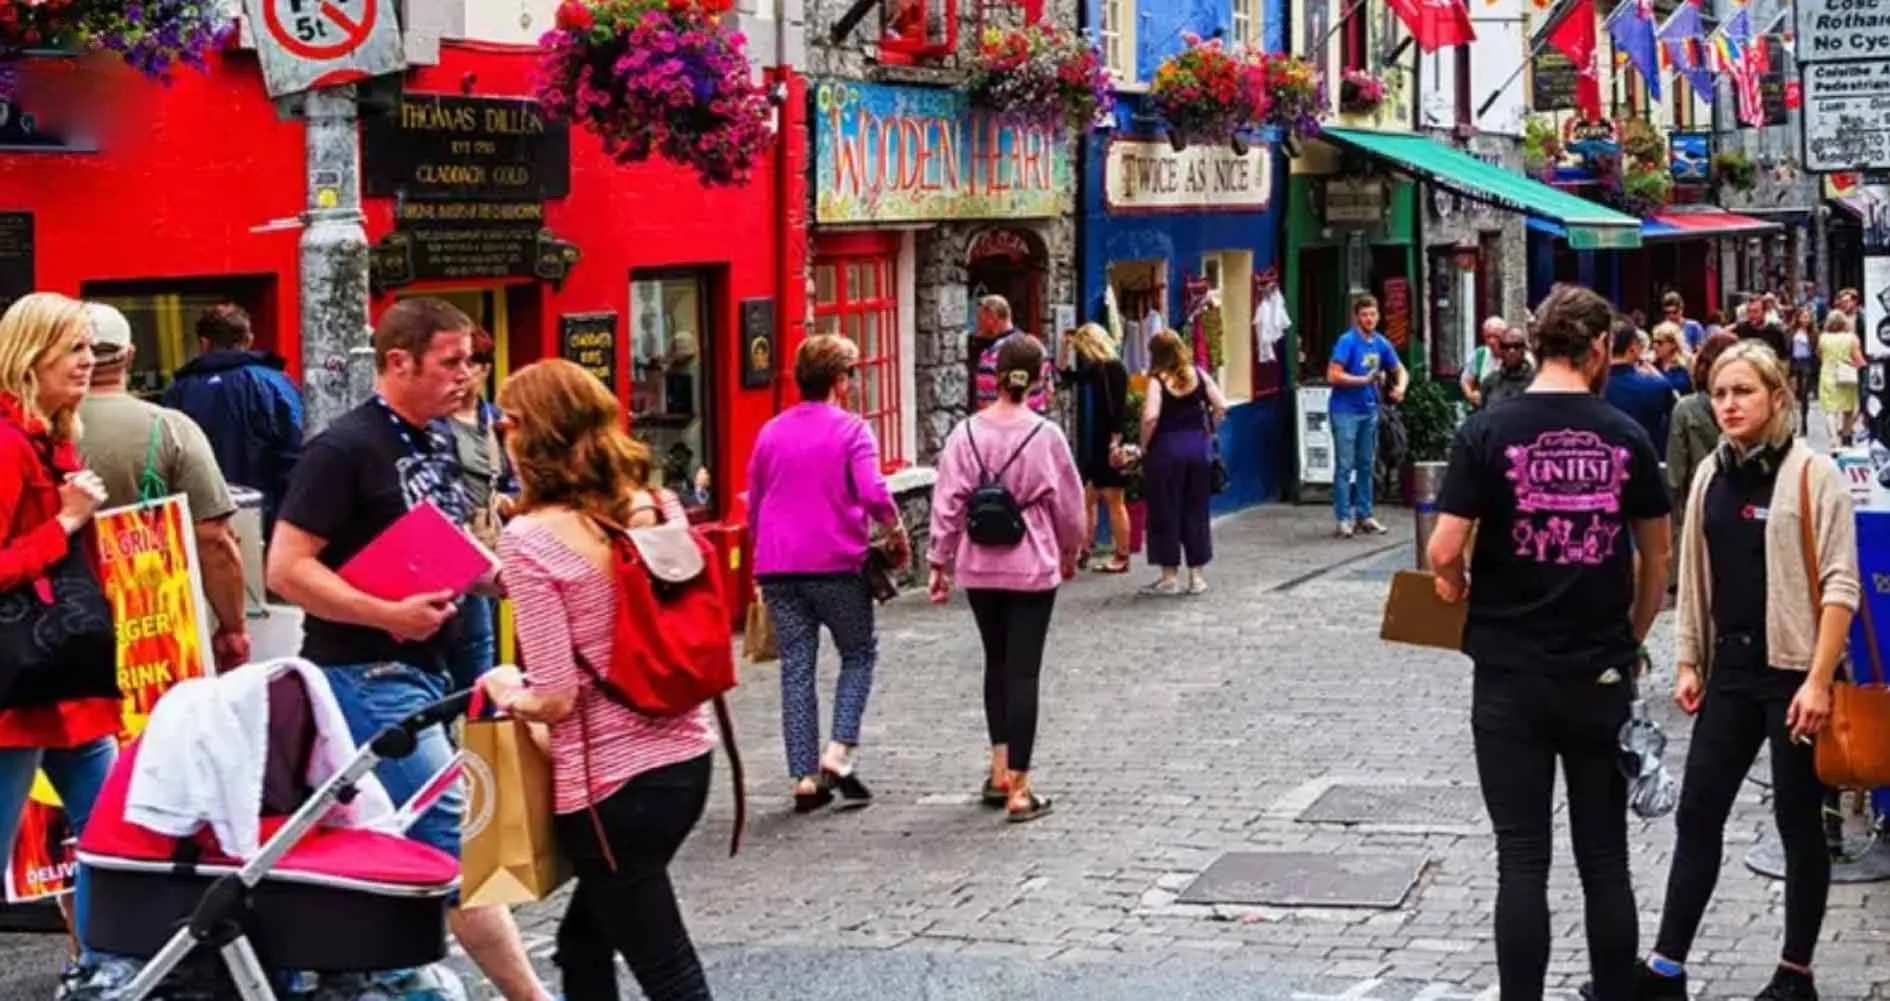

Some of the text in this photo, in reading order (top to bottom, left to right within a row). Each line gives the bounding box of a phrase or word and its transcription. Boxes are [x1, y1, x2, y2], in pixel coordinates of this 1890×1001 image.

[296, 16, 327, 41] 5t
[1813, 35, 1842, 51] No
[401, 103, 477, 132] THOMAS
[831, 104, 963, 200] WOODEN
[1121, 154, 1177, 197] TWICE
[1184, 159, 1206, 193] AS
[1213, 159, 1248, 193] NICE
